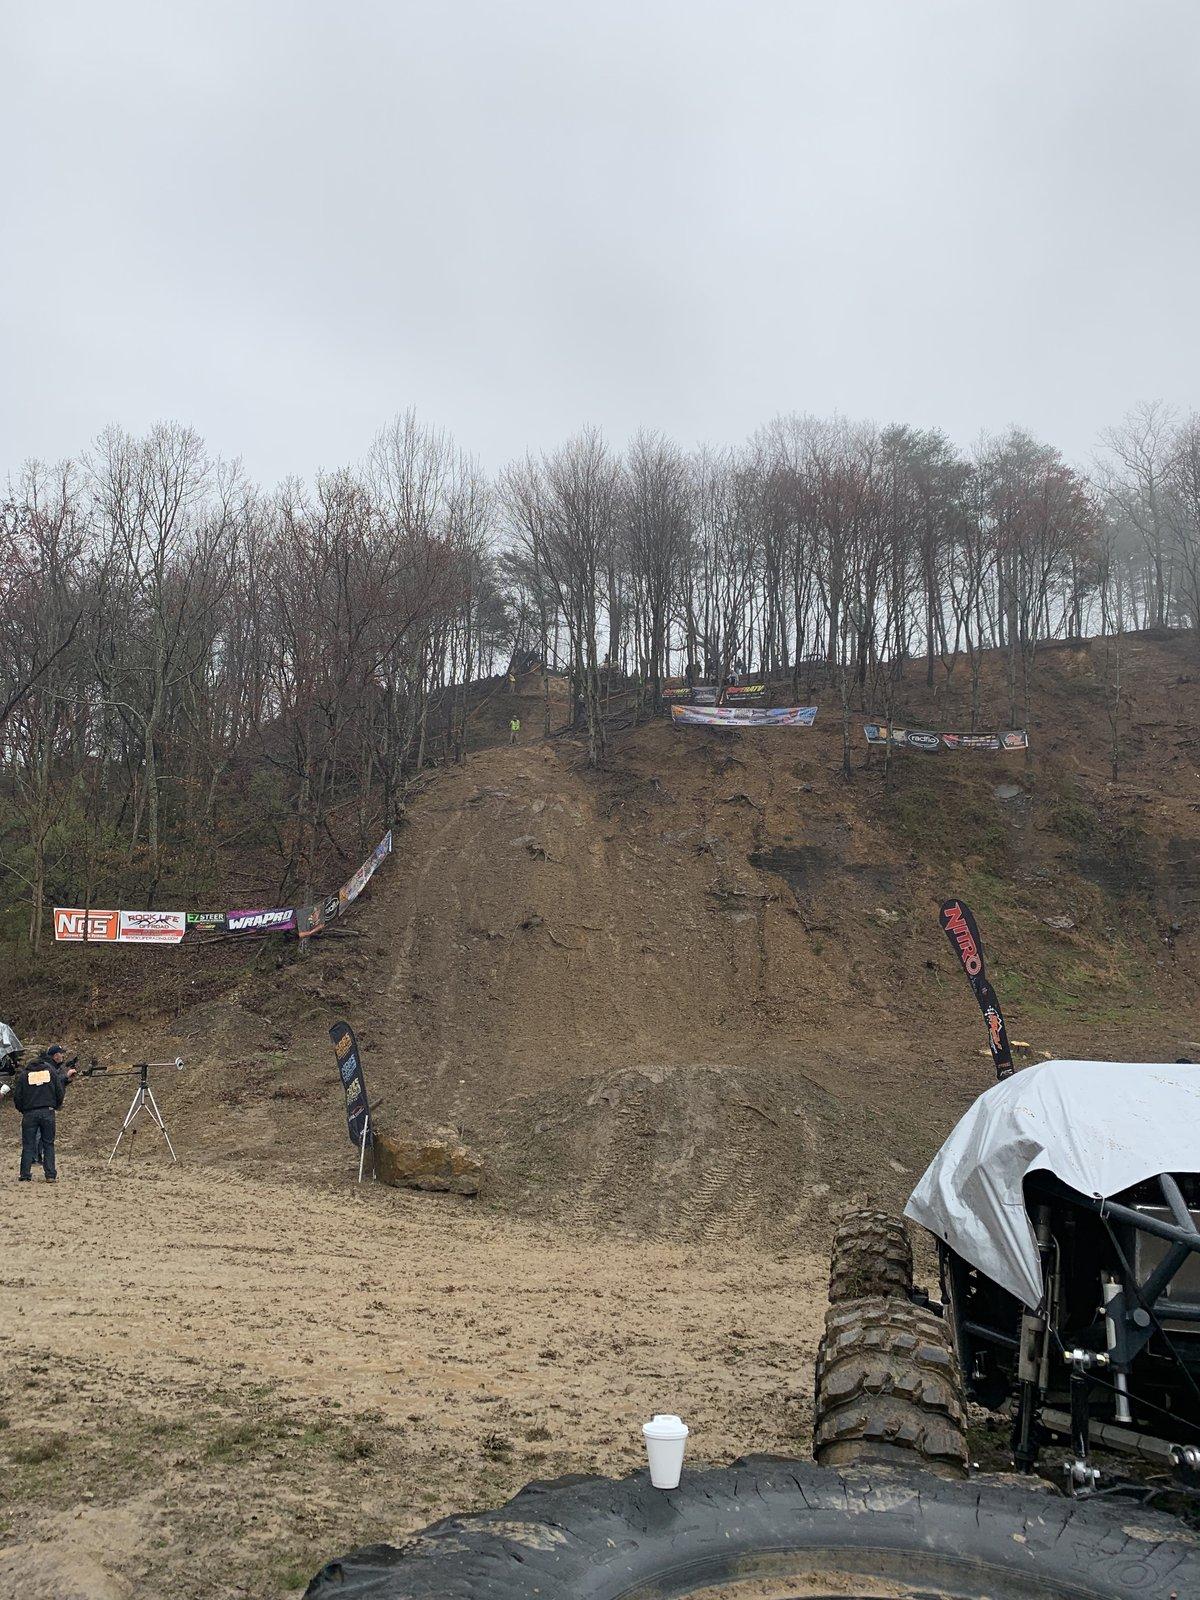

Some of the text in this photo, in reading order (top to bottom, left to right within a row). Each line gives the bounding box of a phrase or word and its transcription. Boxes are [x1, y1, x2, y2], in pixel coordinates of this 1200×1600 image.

[58, 913, 108, 935] NOS
[128, 914, 181, 923] ROCK LIFE
[187, 914, 200, 923] EZ
[944, 902, 982, 976] NITRO
